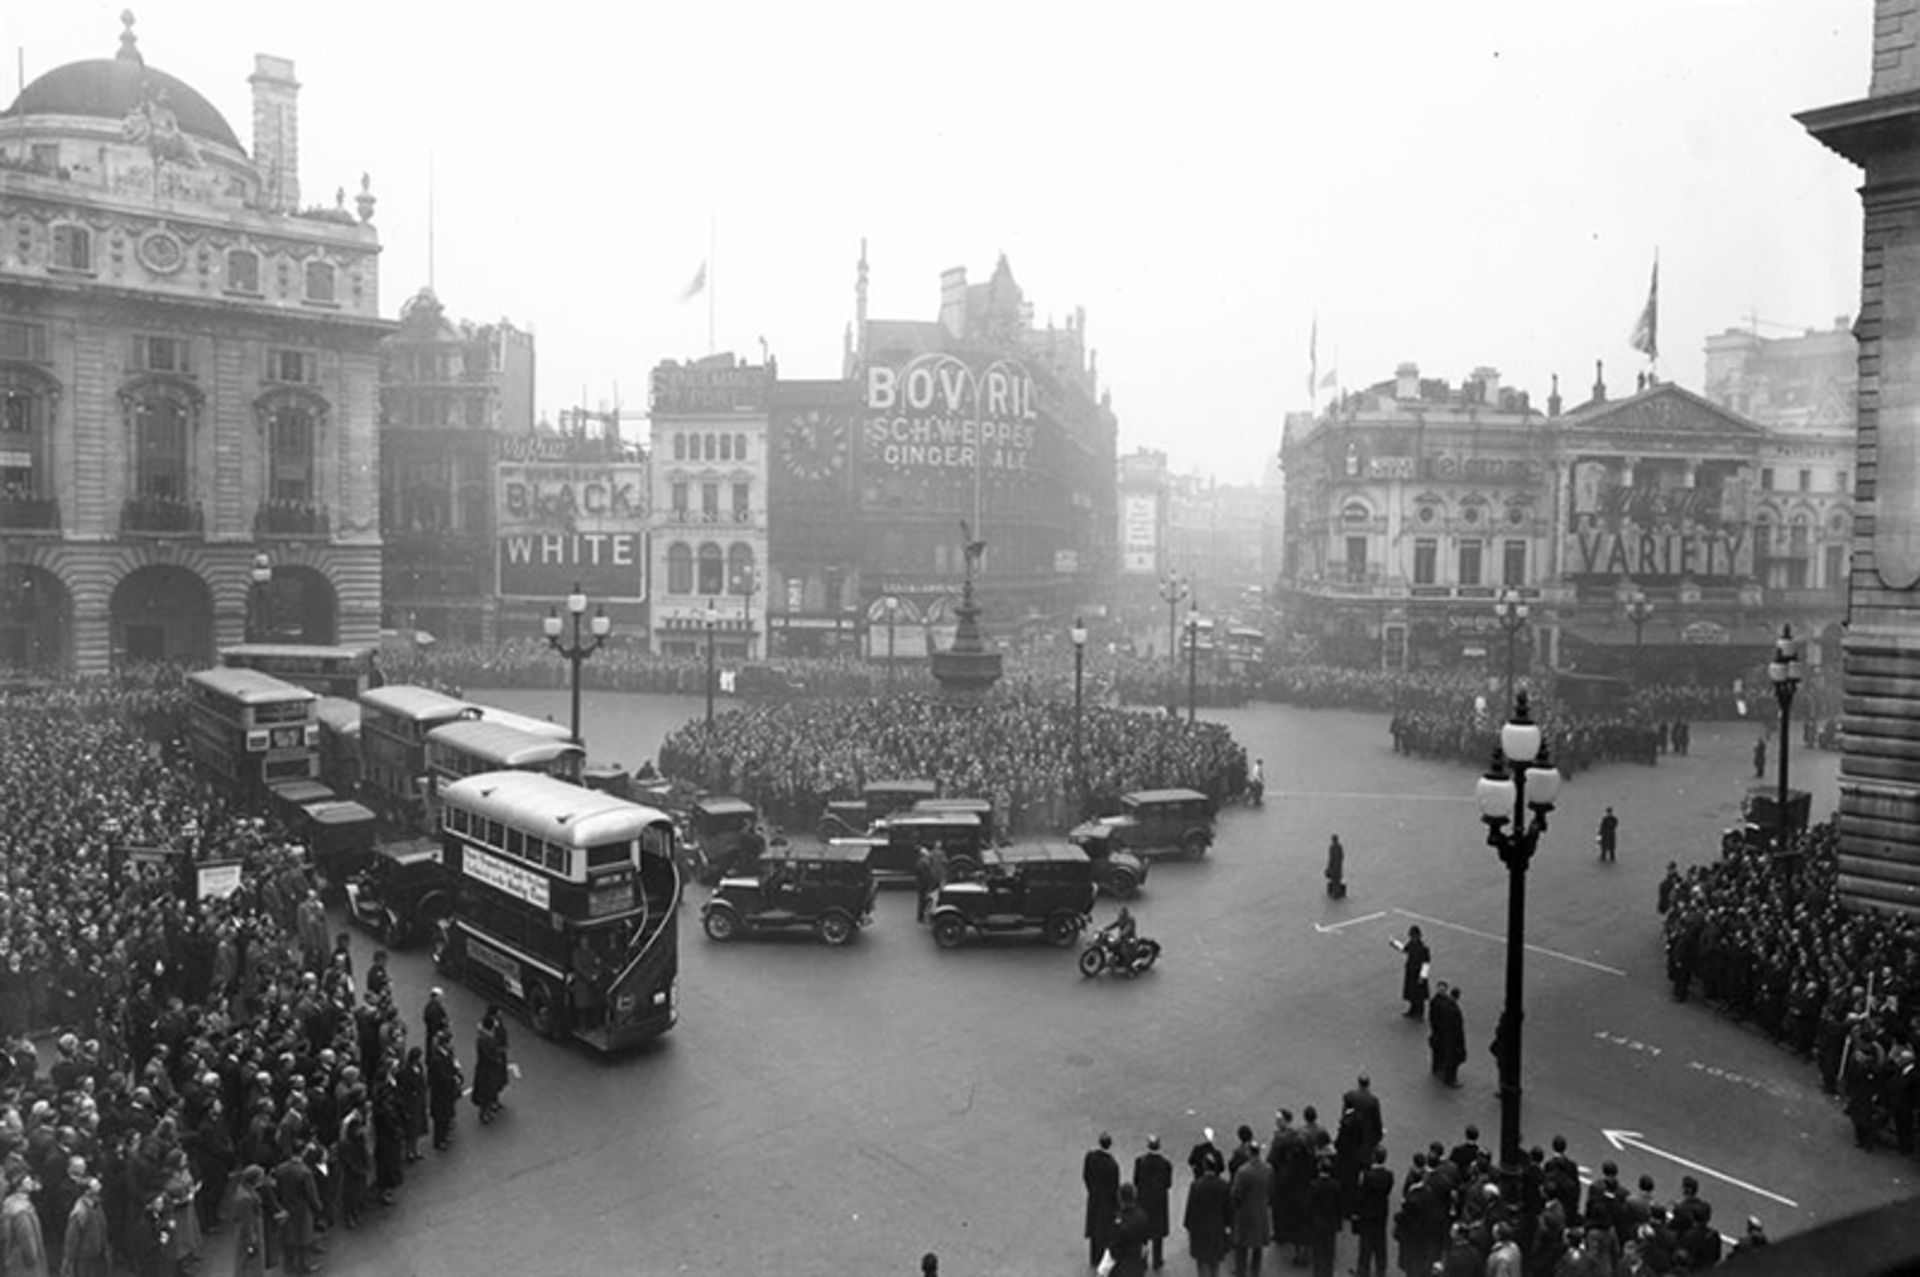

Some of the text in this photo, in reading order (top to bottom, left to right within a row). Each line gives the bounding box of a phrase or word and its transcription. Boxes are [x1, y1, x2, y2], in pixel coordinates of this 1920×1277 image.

[868, 366, 1037, 419] BOVRIL
[884, 444, 975, 472] GINGER
[506, 482, 633, 516] BLACK
[507, 534, 633, 565] WHITE
[1578, 532, 1743, 575] VARIETY
